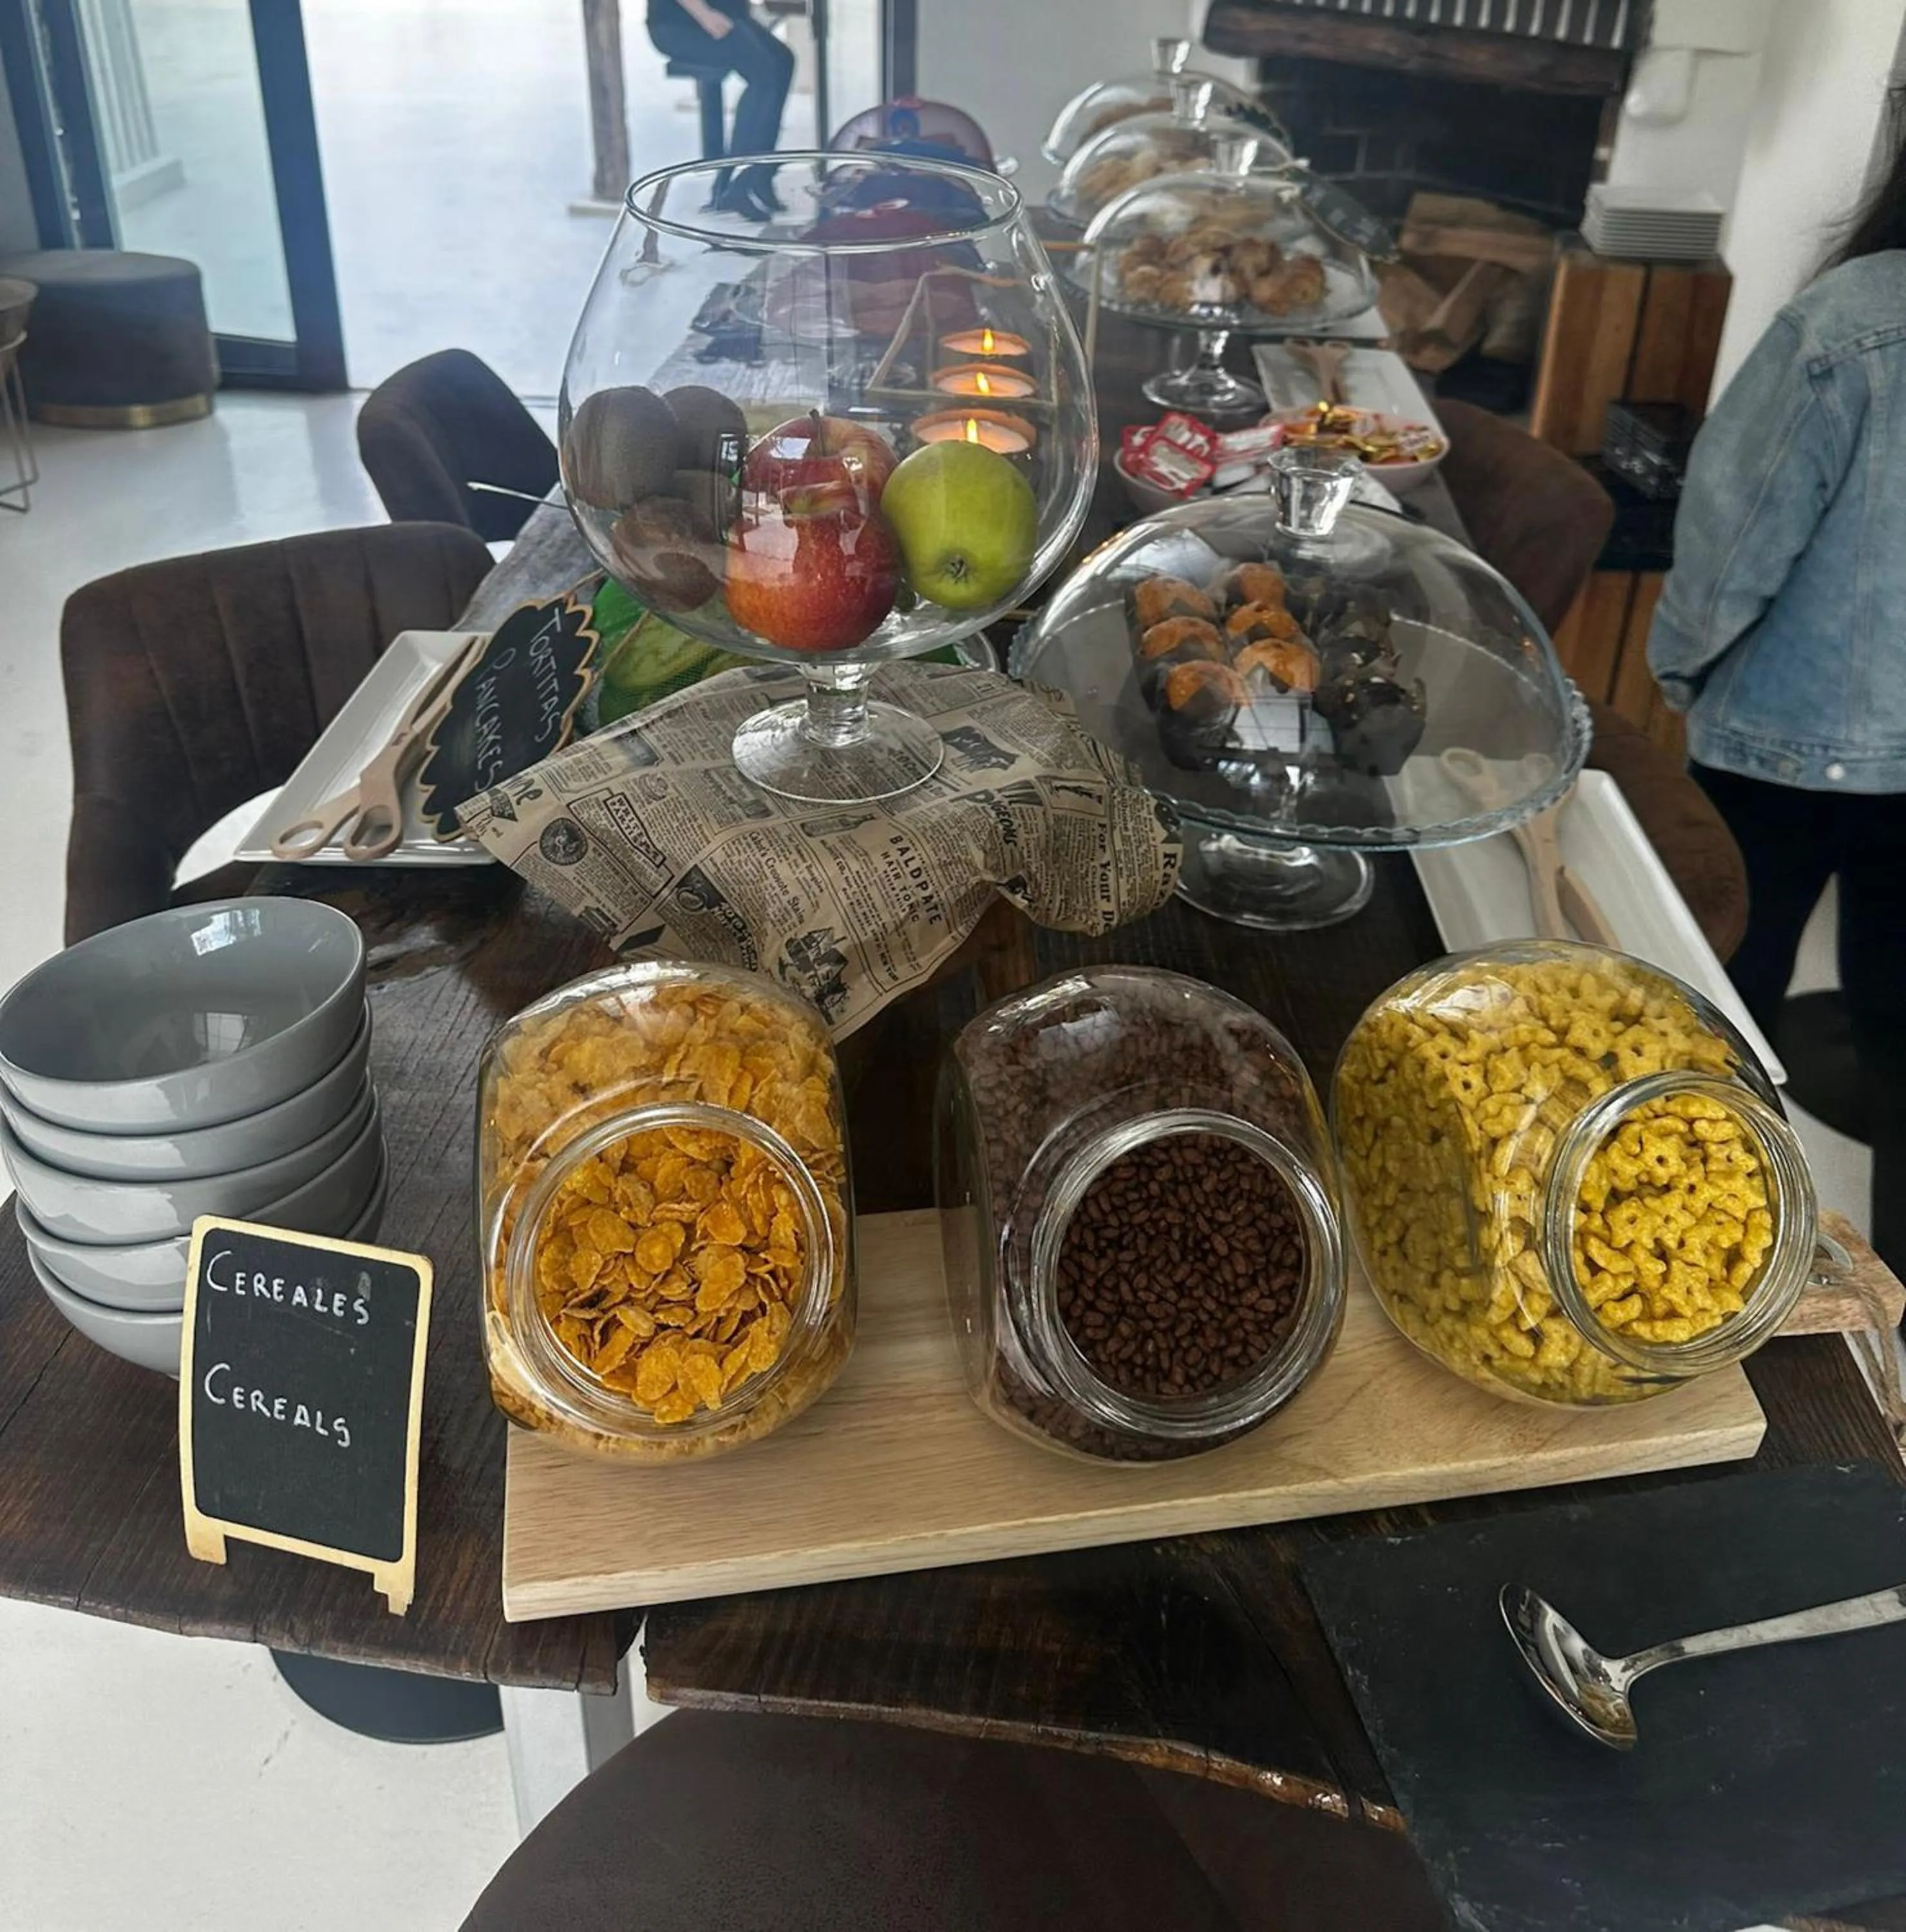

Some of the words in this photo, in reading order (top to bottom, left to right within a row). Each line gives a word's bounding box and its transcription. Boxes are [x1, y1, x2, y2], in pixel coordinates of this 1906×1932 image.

[529, 607, 563, 743] TORTITAS
[473, 647, 516, 791] PANCAKES
[1097, 823, 1108, 853] For
[881, 851, 902, 881] HAIR
[900, 886, 920, 923] TONIC
[889, 835, 942, 925] BALDPATE
[1099, 861, 1111, 903] Your
[206, 1250, 370, 1325] CEREALES
[204, 1362, 351, 1448] CEREALS
